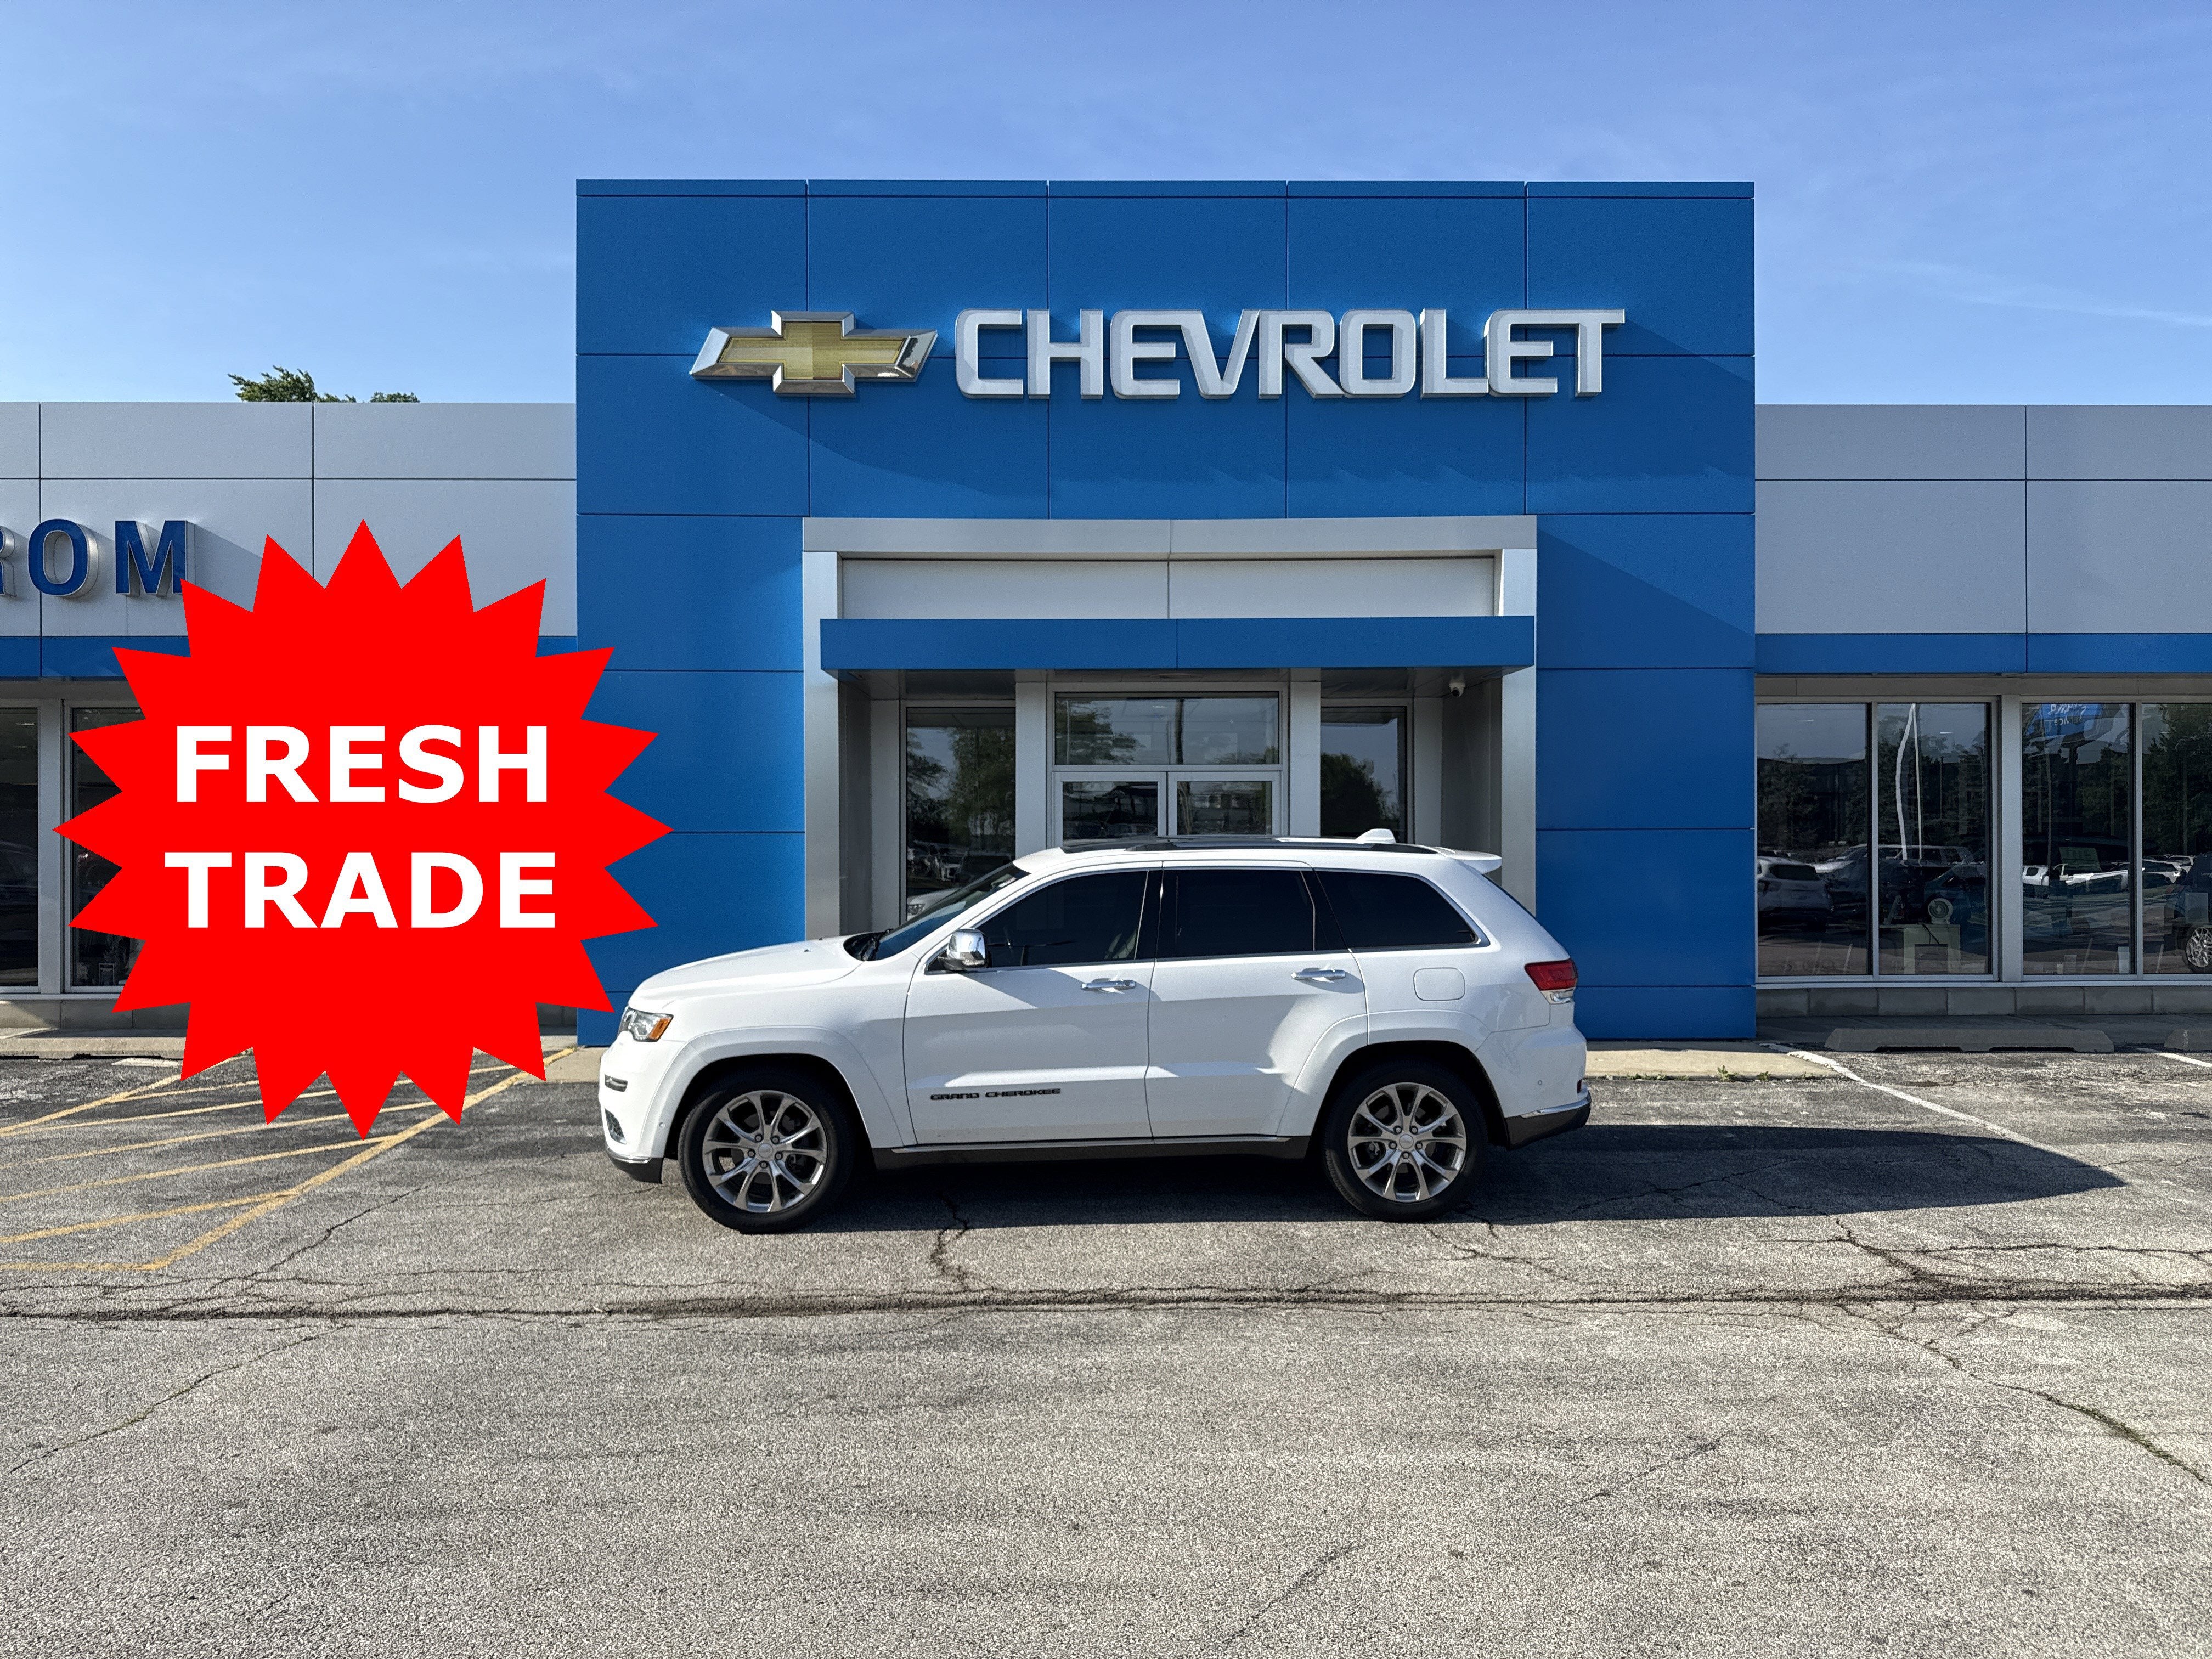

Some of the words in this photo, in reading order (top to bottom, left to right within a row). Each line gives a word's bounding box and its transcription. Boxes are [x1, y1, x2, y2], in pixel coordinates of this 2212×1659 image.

[955, 308, 1626, 399] CHEVROLET
[0, 518, 187, 596] OM
[930, 1092, 980, 1101] GRAND
[985, 1088, 1062, 1098] CHEROKEE
